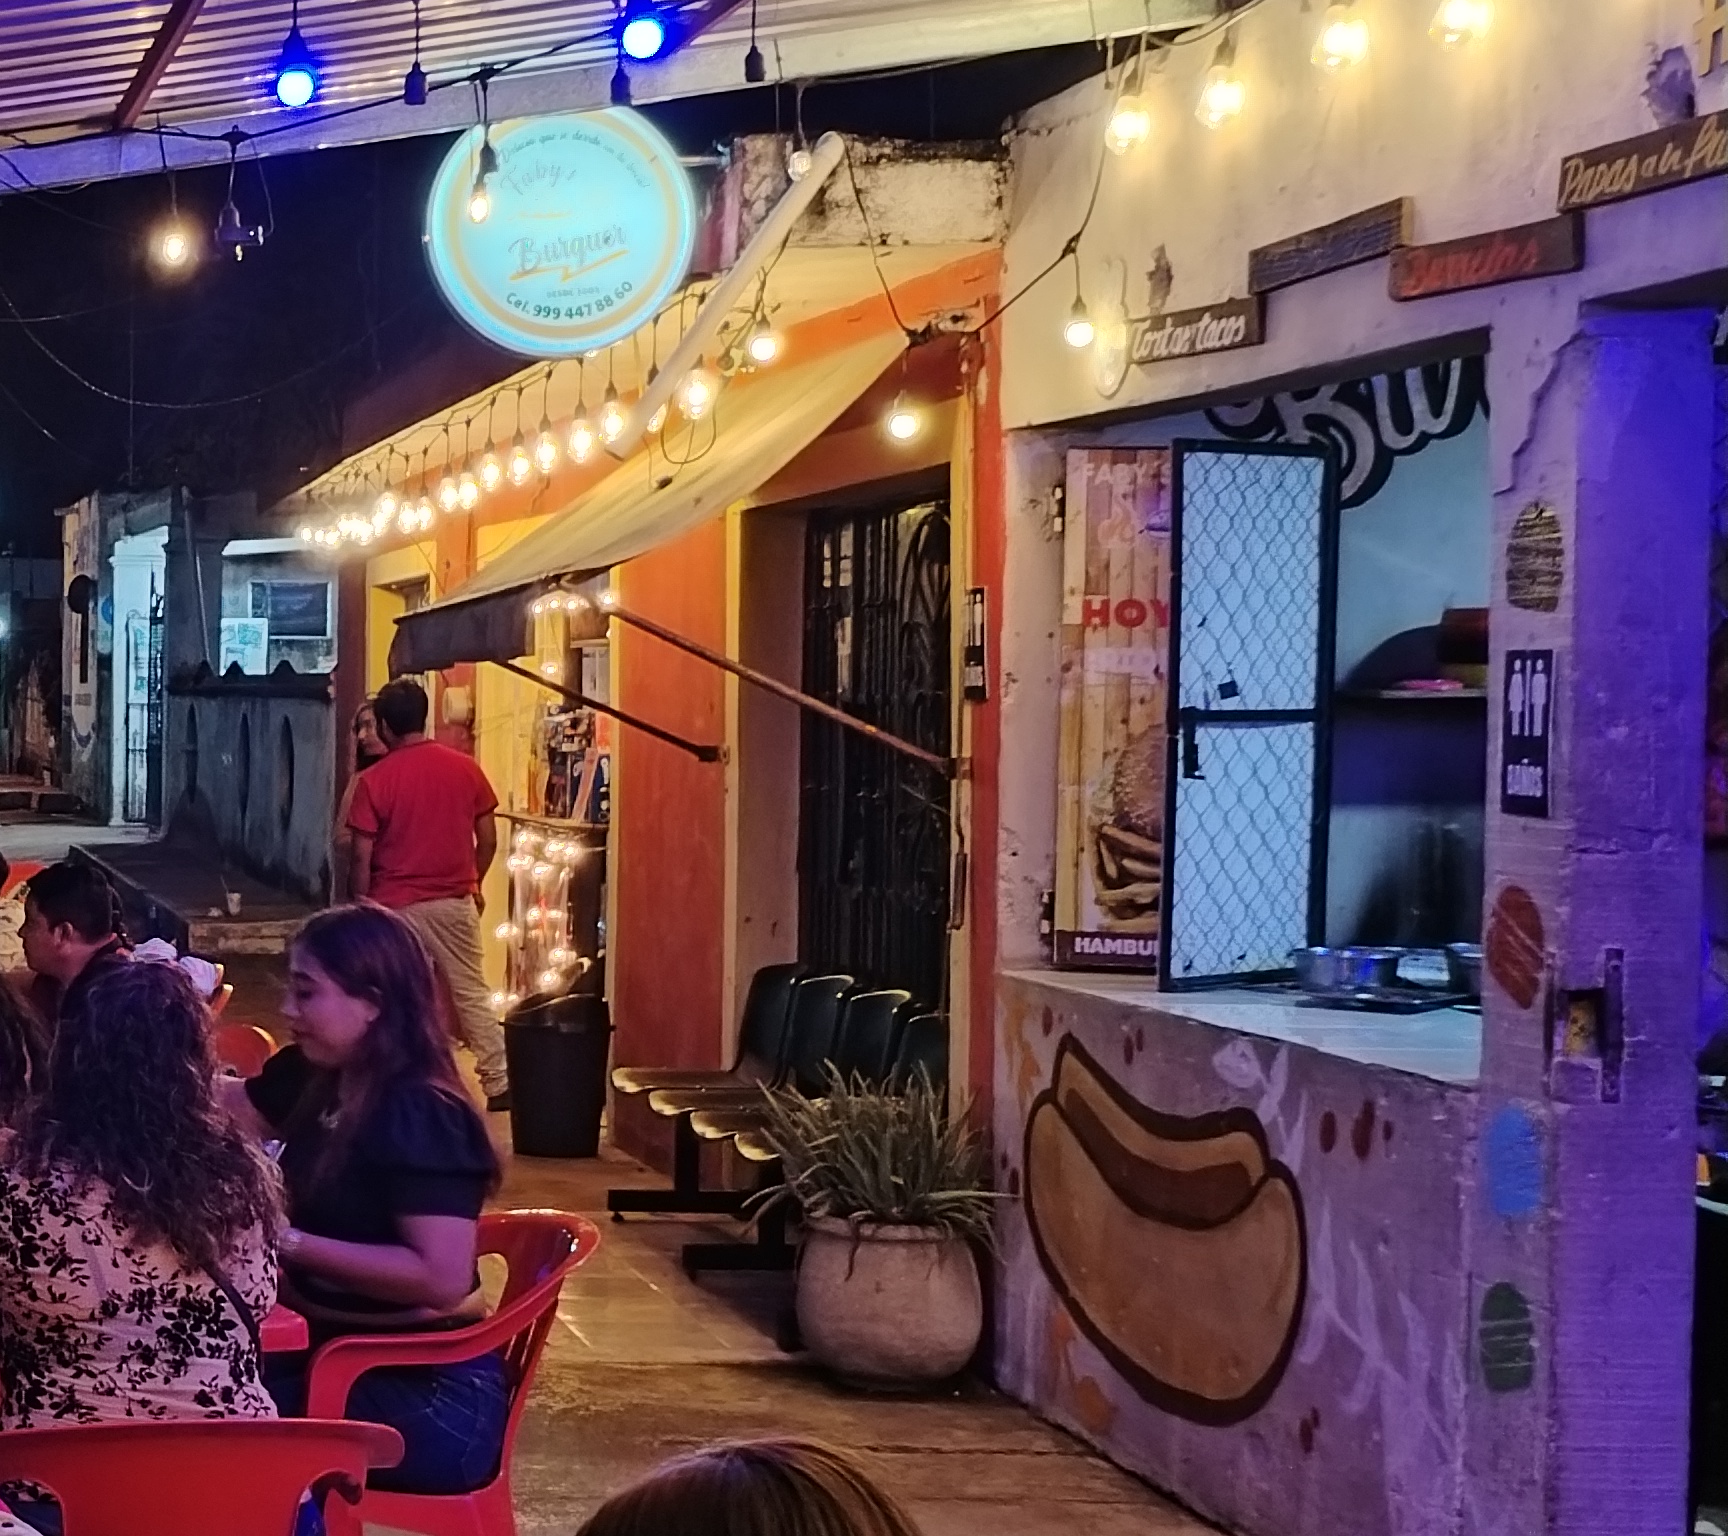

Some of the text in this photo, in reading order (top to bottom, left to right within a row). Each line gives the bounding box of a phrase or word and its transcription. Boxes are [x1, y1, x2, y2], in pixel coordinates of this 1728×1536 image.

[533, 304, 561, 320] 999
[564, 302, 592, 319] 447
[594, 294, 614, 312] 88
[613, 280, 633, 300] 60
